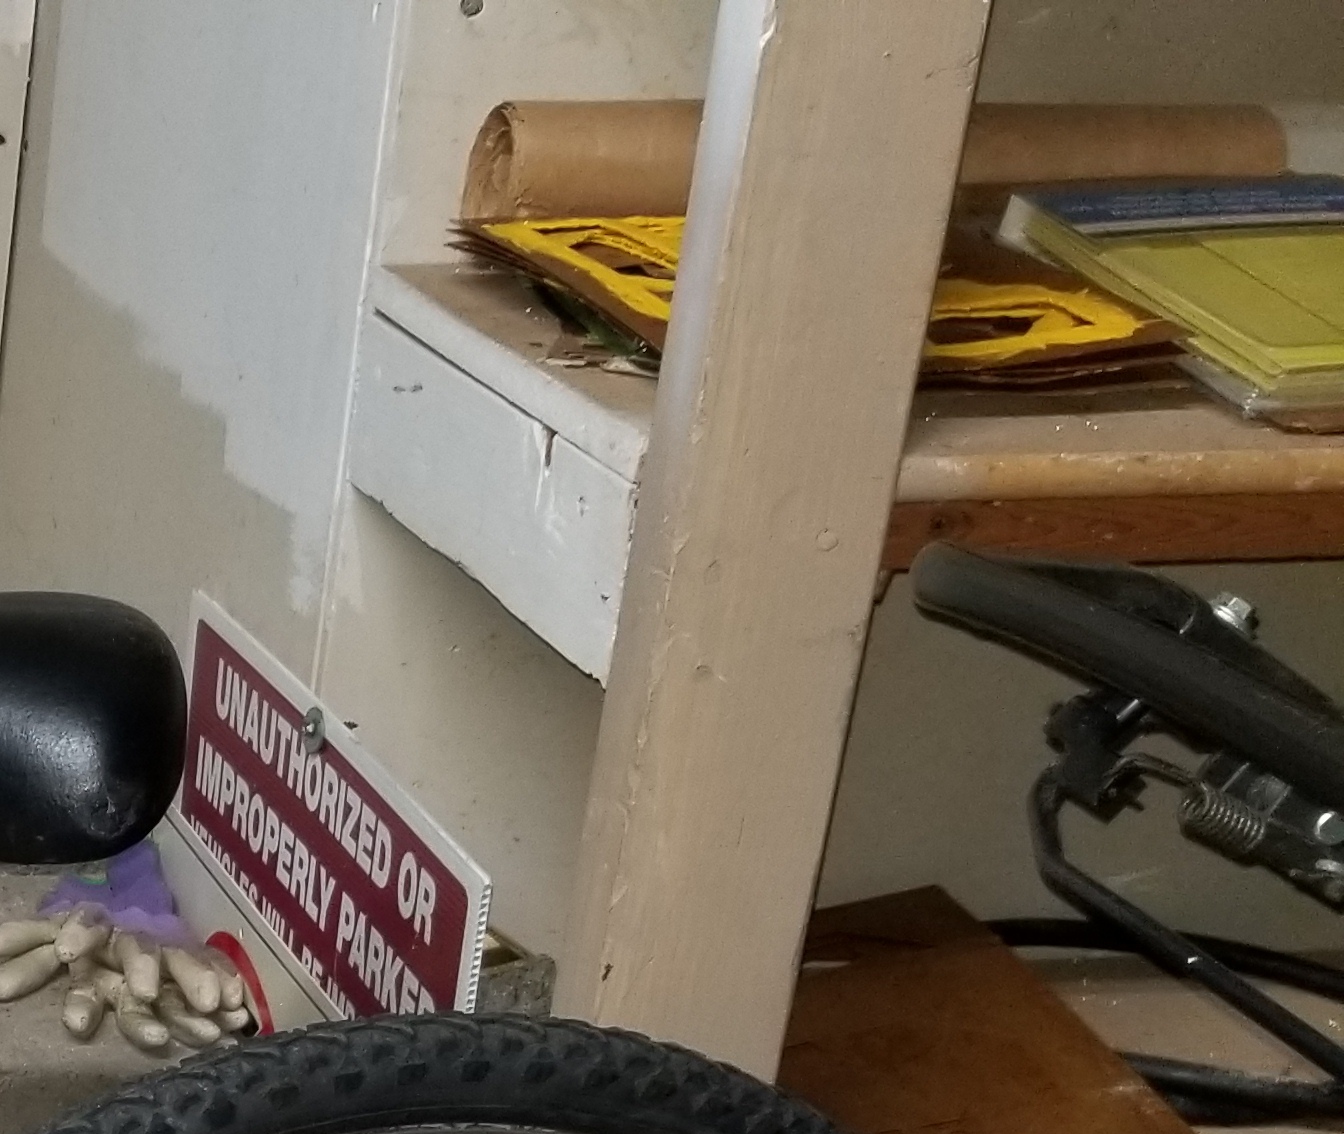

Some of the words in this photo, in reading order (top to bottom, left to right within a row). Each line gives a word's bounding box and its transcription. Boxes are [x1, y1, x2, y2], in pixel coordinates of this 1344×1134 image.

[196, 735, 337, 931] IMPROPERLY
[216, 659, 392, 888] UNAUTHORIZED
[398, 852, 437, 946] OR
